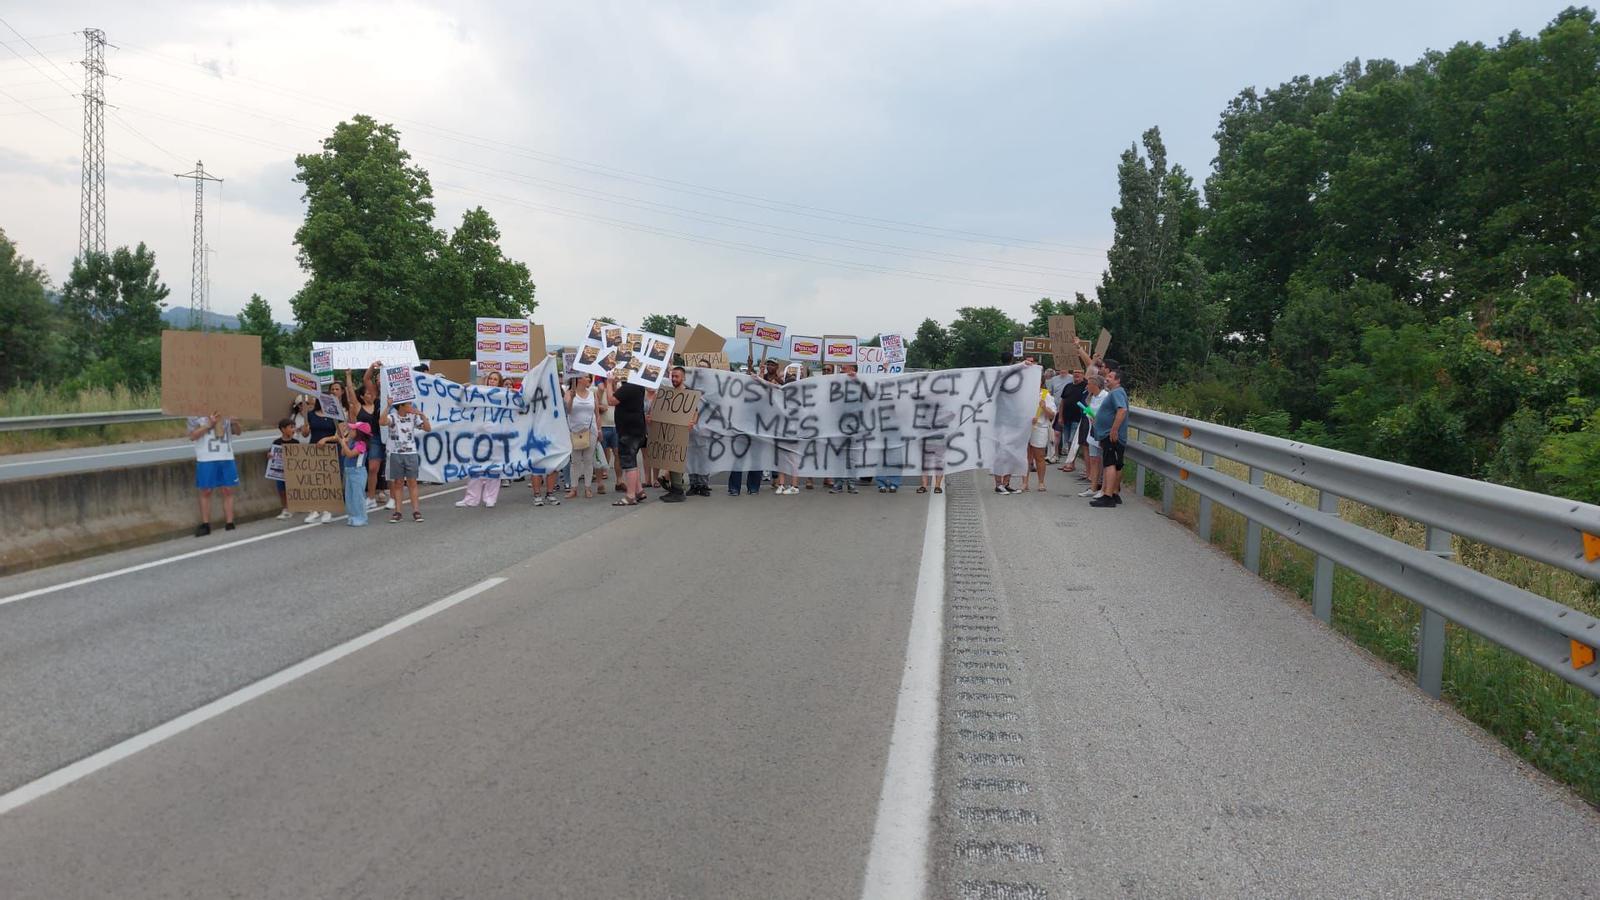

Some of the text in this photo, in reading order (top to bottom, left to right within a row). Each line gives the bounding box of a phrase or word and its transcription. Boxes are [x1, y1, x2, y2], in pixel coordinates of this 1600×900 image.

[757, 327, 781, 340] Pascual
[795, 343, 818, 353] Pascual
[829, 345, 852, 354] Pascual
[715, 374, 818, 409] VOSTRE
[828, 374, 962, 404] BENEFICI
[969, 368, 1023, 401] NO
[755, 407, 820, 440] MÉS
[839, 404, 900, 437] QUE
[912, 403, 949, 430] EL
[659, 423, 676, 443] NO
[285, 445, 337, 457] NO VOLEM
[708, 431, 751, 461] 80
[444, 459, 546, 483] PASCUAL
[296, 472, 332, 486] VOLEM
[287, 488, 343, 500] SOLUCIONS
